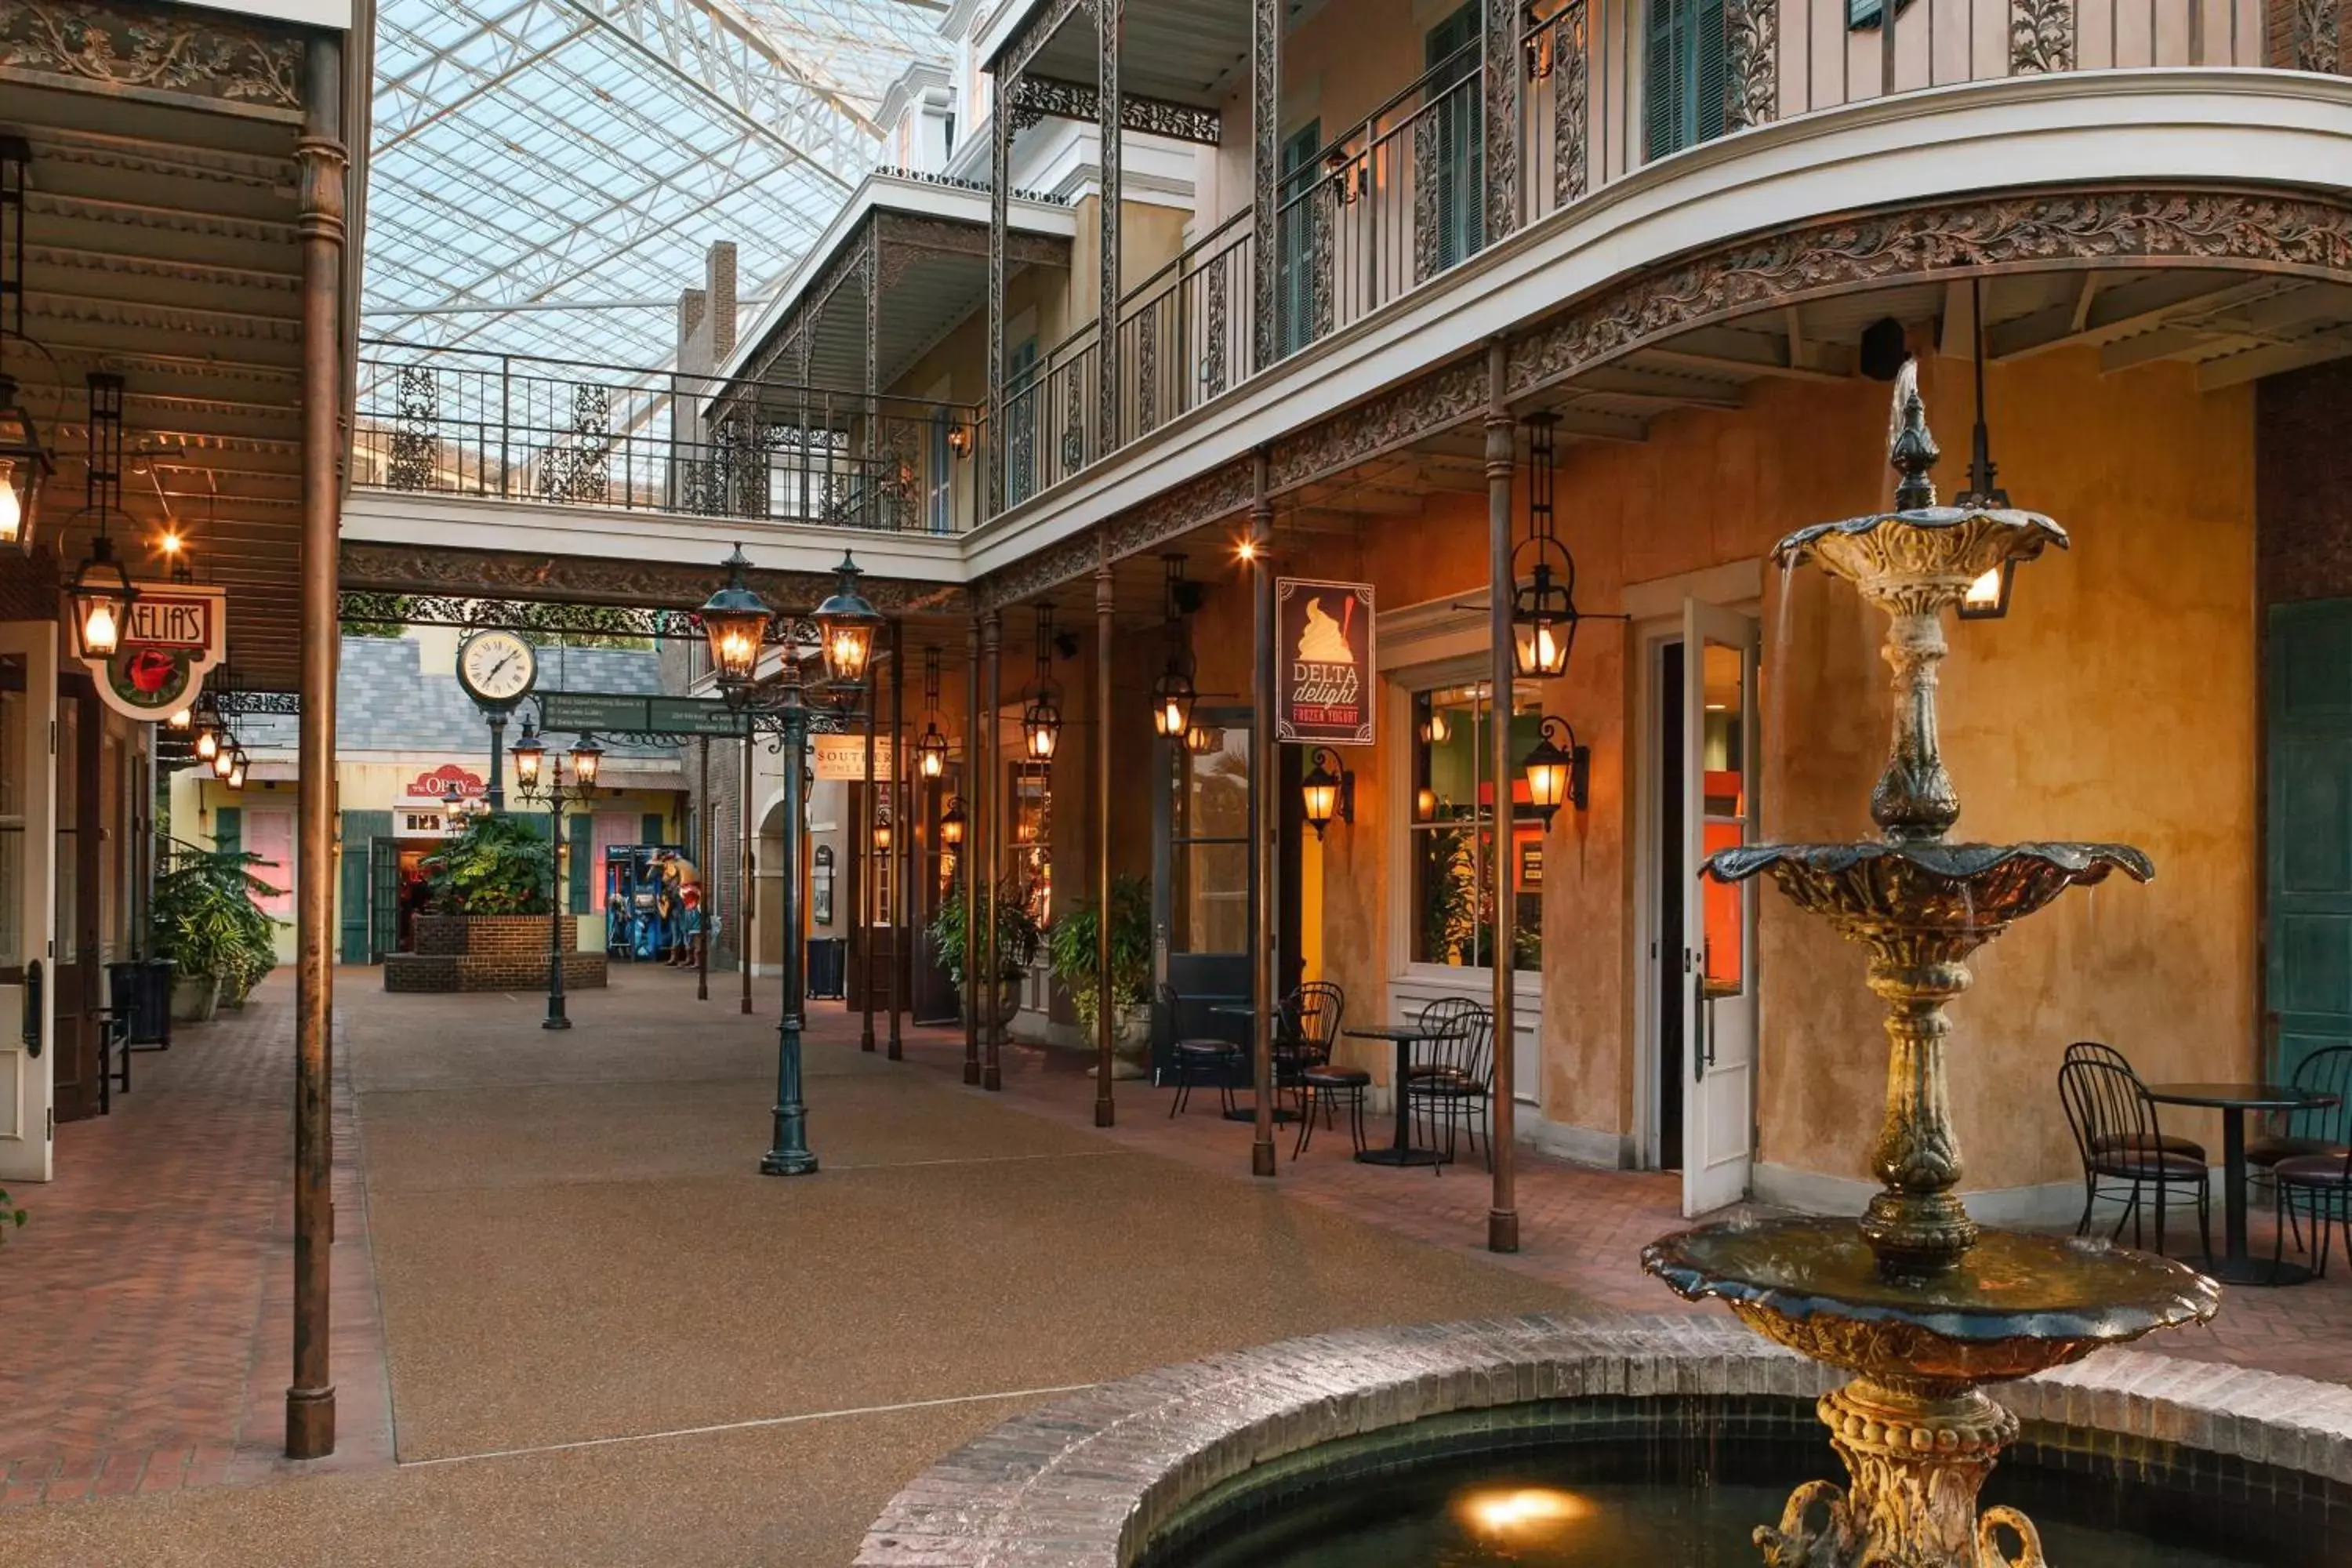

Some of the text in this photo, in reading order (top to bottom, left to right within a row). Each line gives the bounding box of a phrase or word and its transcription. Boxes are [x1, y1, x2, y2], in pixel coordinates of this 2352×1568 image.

[1293, 663, 1359, 684] DELTA
[1292, 681, 1359, 710] delight
[1293, 708, 1358, 724] FROZEN YOGURT
